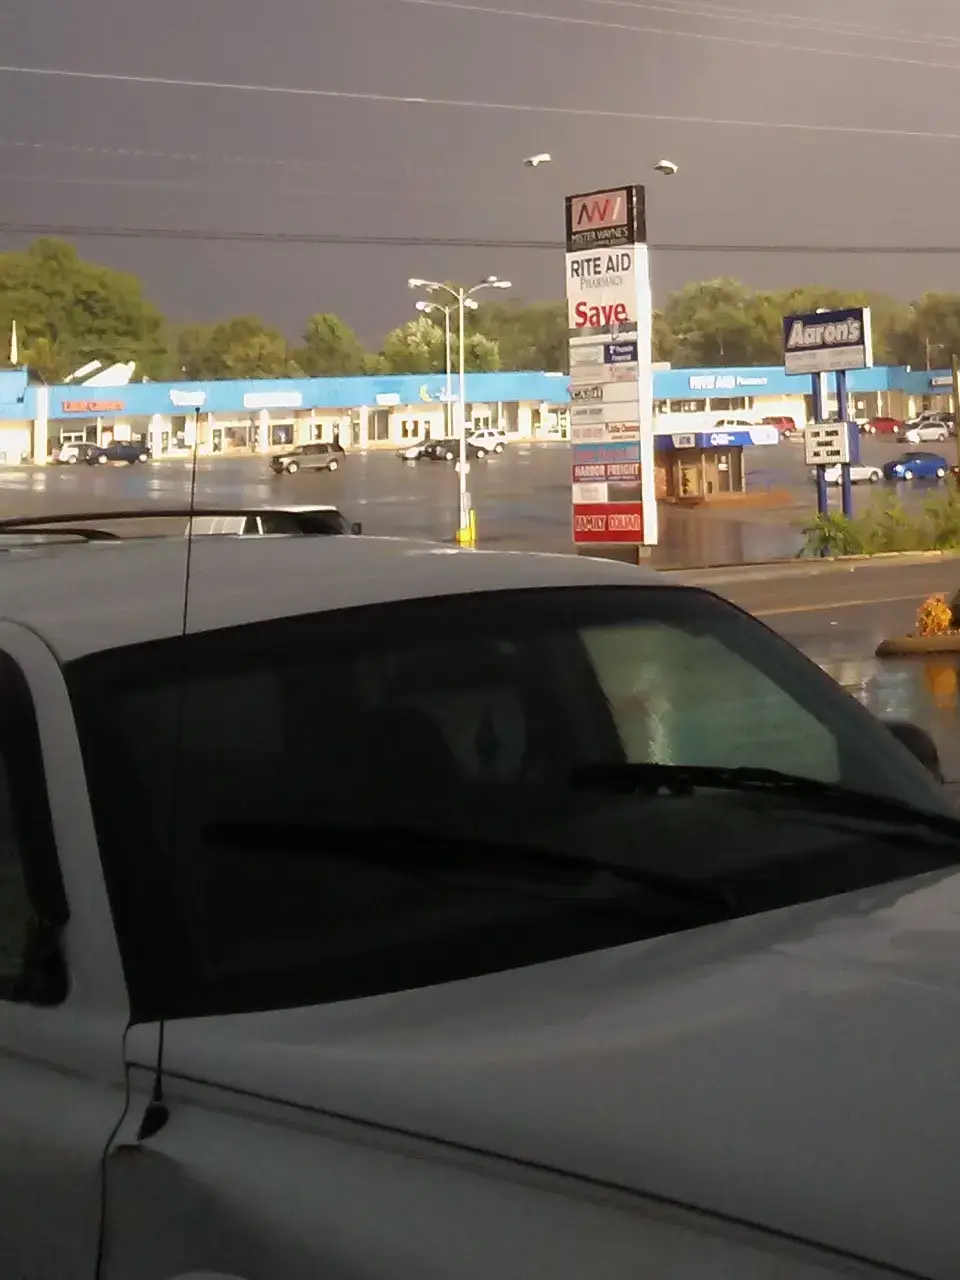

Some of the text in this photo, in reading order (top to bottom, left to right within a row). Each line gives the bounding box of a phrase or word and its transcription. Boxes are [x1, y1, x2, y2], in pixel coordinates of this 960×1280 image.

[570, 252, 632, 278] RITE AID
[580, 276, 624, 291] PHARMACY
[575, 301, 627, 328] Save
[786, 317, 861, 349] Aaron's
